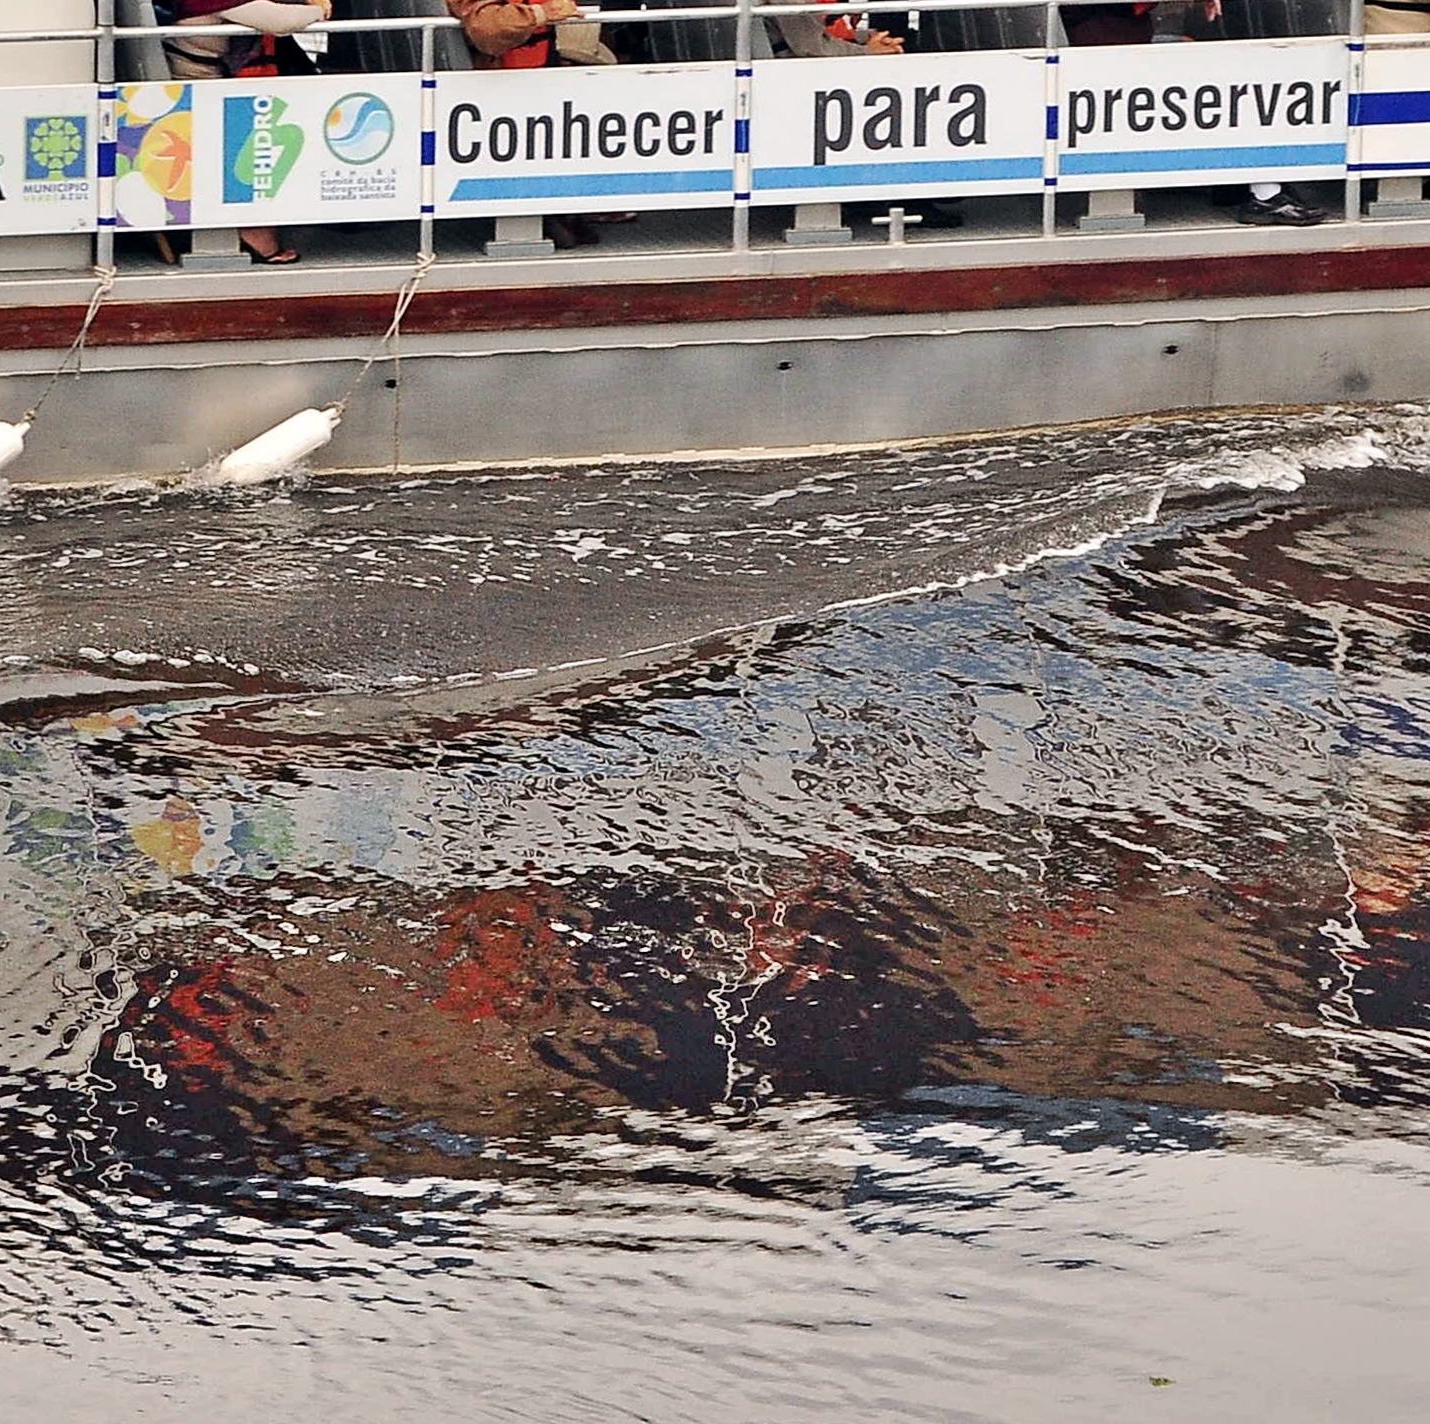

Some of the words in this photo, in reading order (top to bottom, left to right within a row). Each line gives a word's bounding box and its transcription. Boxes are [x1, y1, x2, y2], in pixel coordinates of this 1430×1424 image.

[447, 101, 725, 164] Conhecer
[812, 82, 988, 166] para
[1067, 79, 1342, 149] preservar
